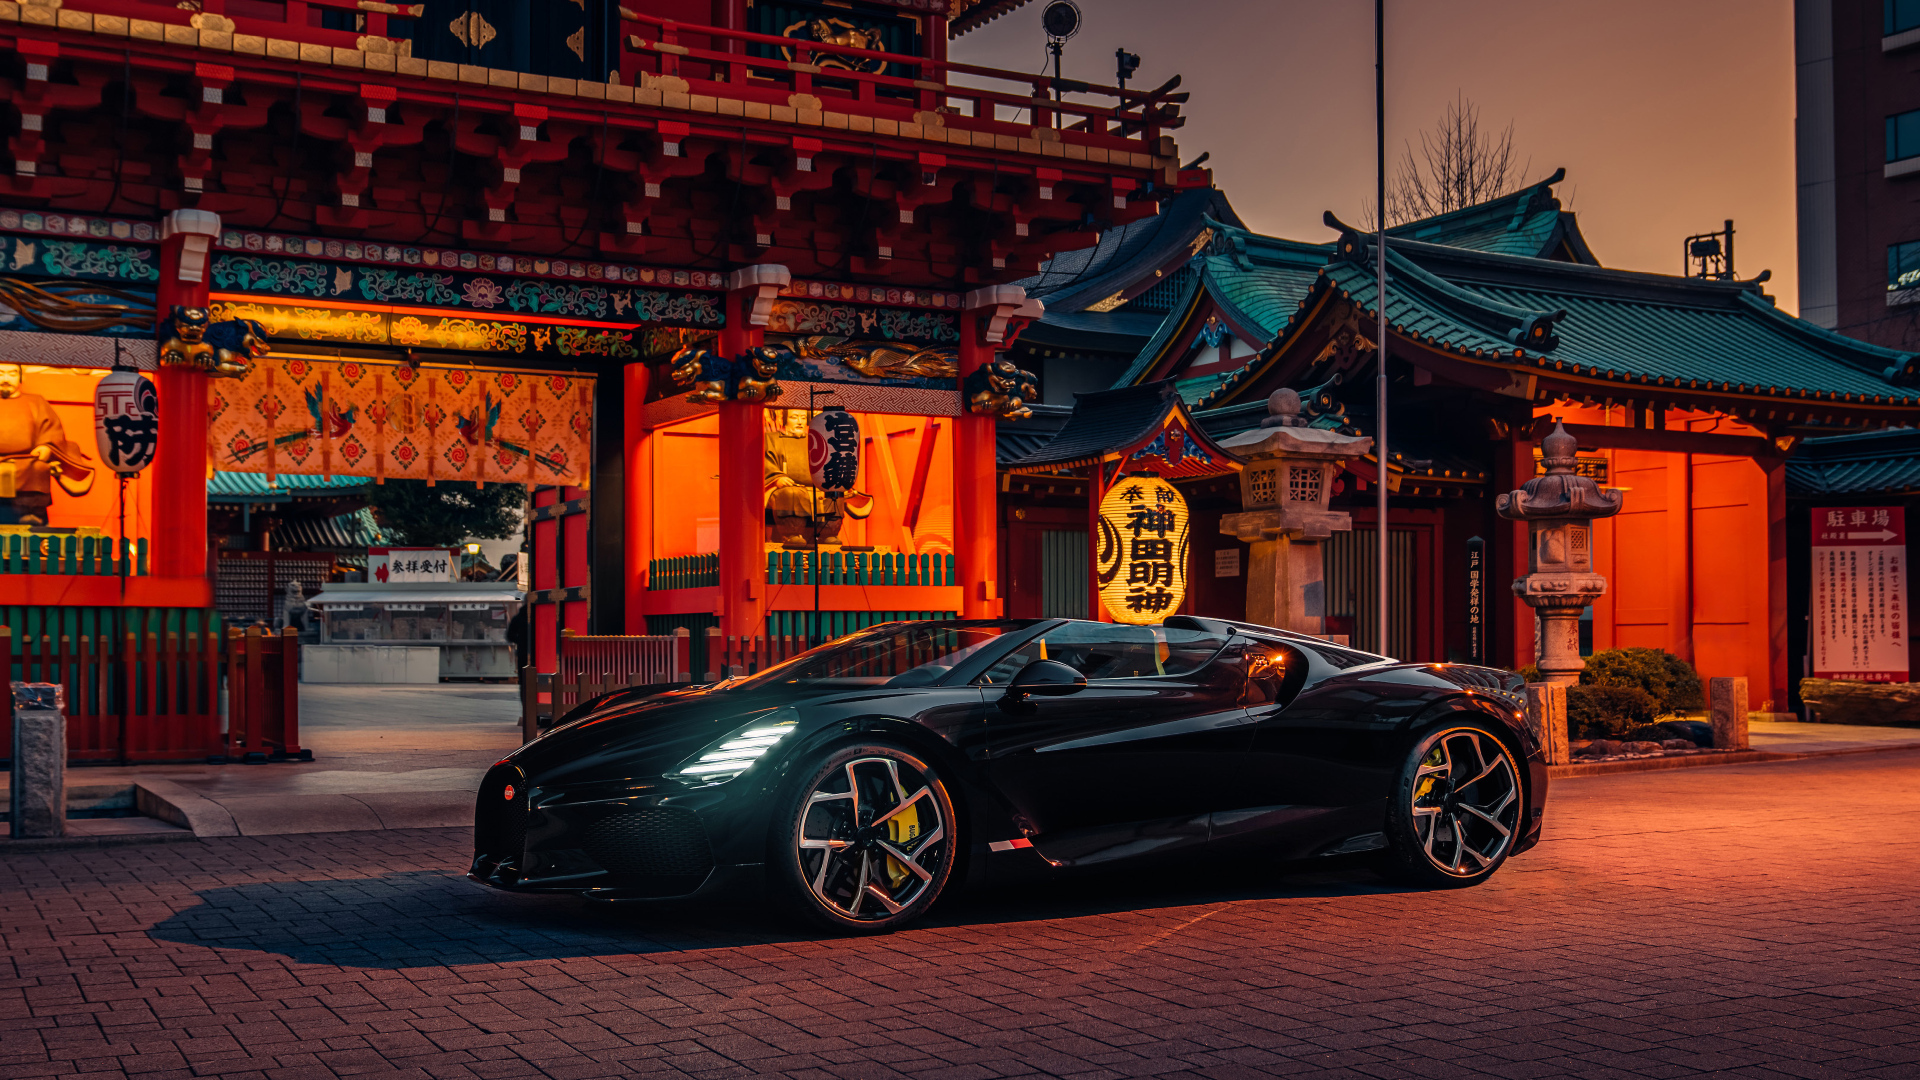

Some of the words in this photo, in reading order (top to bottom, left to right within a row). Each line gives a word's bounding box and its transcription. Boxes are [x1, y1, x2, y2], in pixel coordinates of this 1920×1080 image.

[1826, 509, 1890, 527] 駐車場
[391, 559, 448, 574] 参拝受付
[1125, 504, 1177, 613] 神田明神
[1469, 551, 1480, 624] 江戸国学発祥の地
[1889, 555, 1902, 647] お車でご来社の皆様へ
